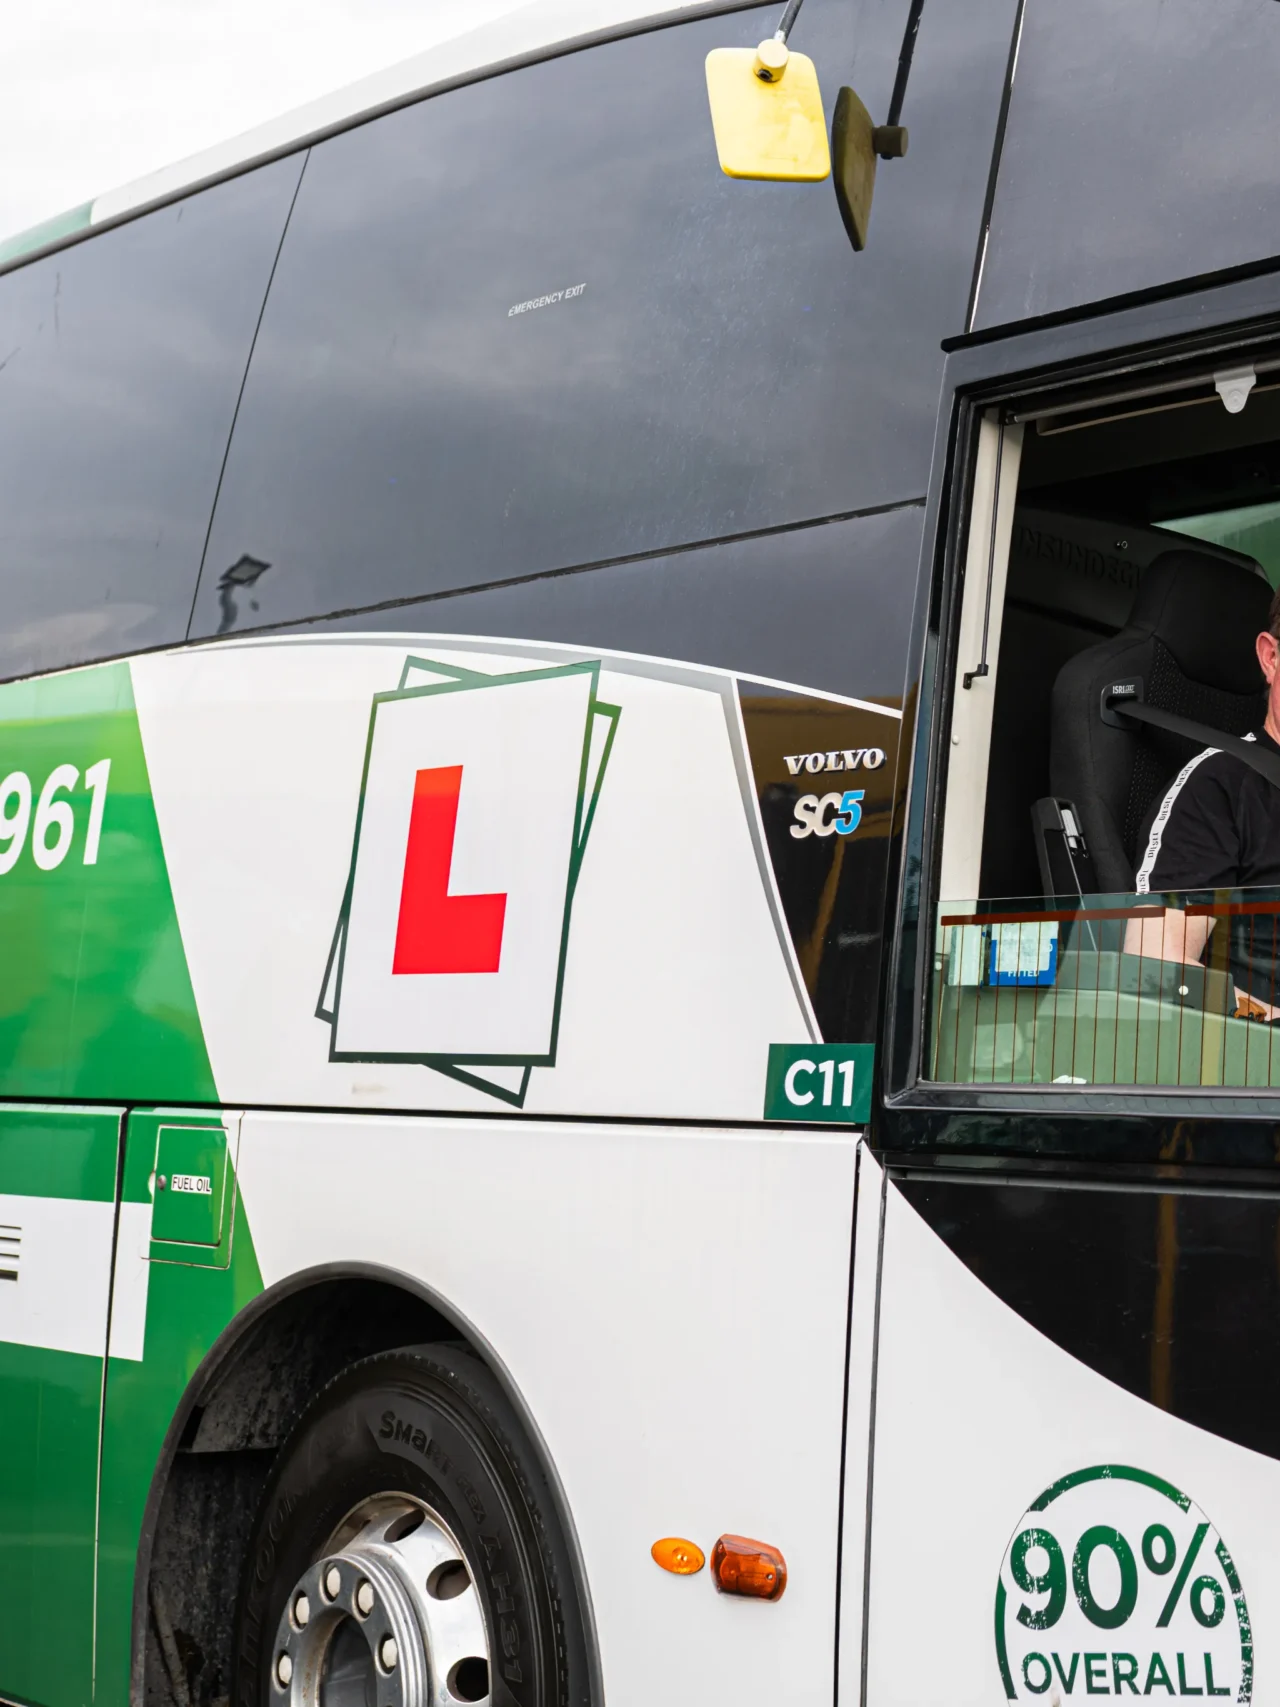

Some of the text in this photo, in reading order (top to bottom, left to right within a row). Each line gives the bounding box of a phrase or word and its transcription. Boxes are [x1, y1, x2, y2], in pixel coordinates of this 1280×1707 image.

[507, 282, 587, 317] EMERGENCY EXIT
[783, 748, 886, 776] VOLVO
[0, 758, 111, 875] 961
[789, 789, 865, 839] SC5
[1159, 796, 1174, 821] DIESEL
[1147, 832, 1159, 858] DIESEL
[392, 765, 508, 975] L
[784, 1059, 855, 1107] C11
[172, 1176, 211, 1192] FUEL OIL
[1010, 1523, 1226, 1631] 90%
[1021, 1652, 1231, 1695] OVERALL
